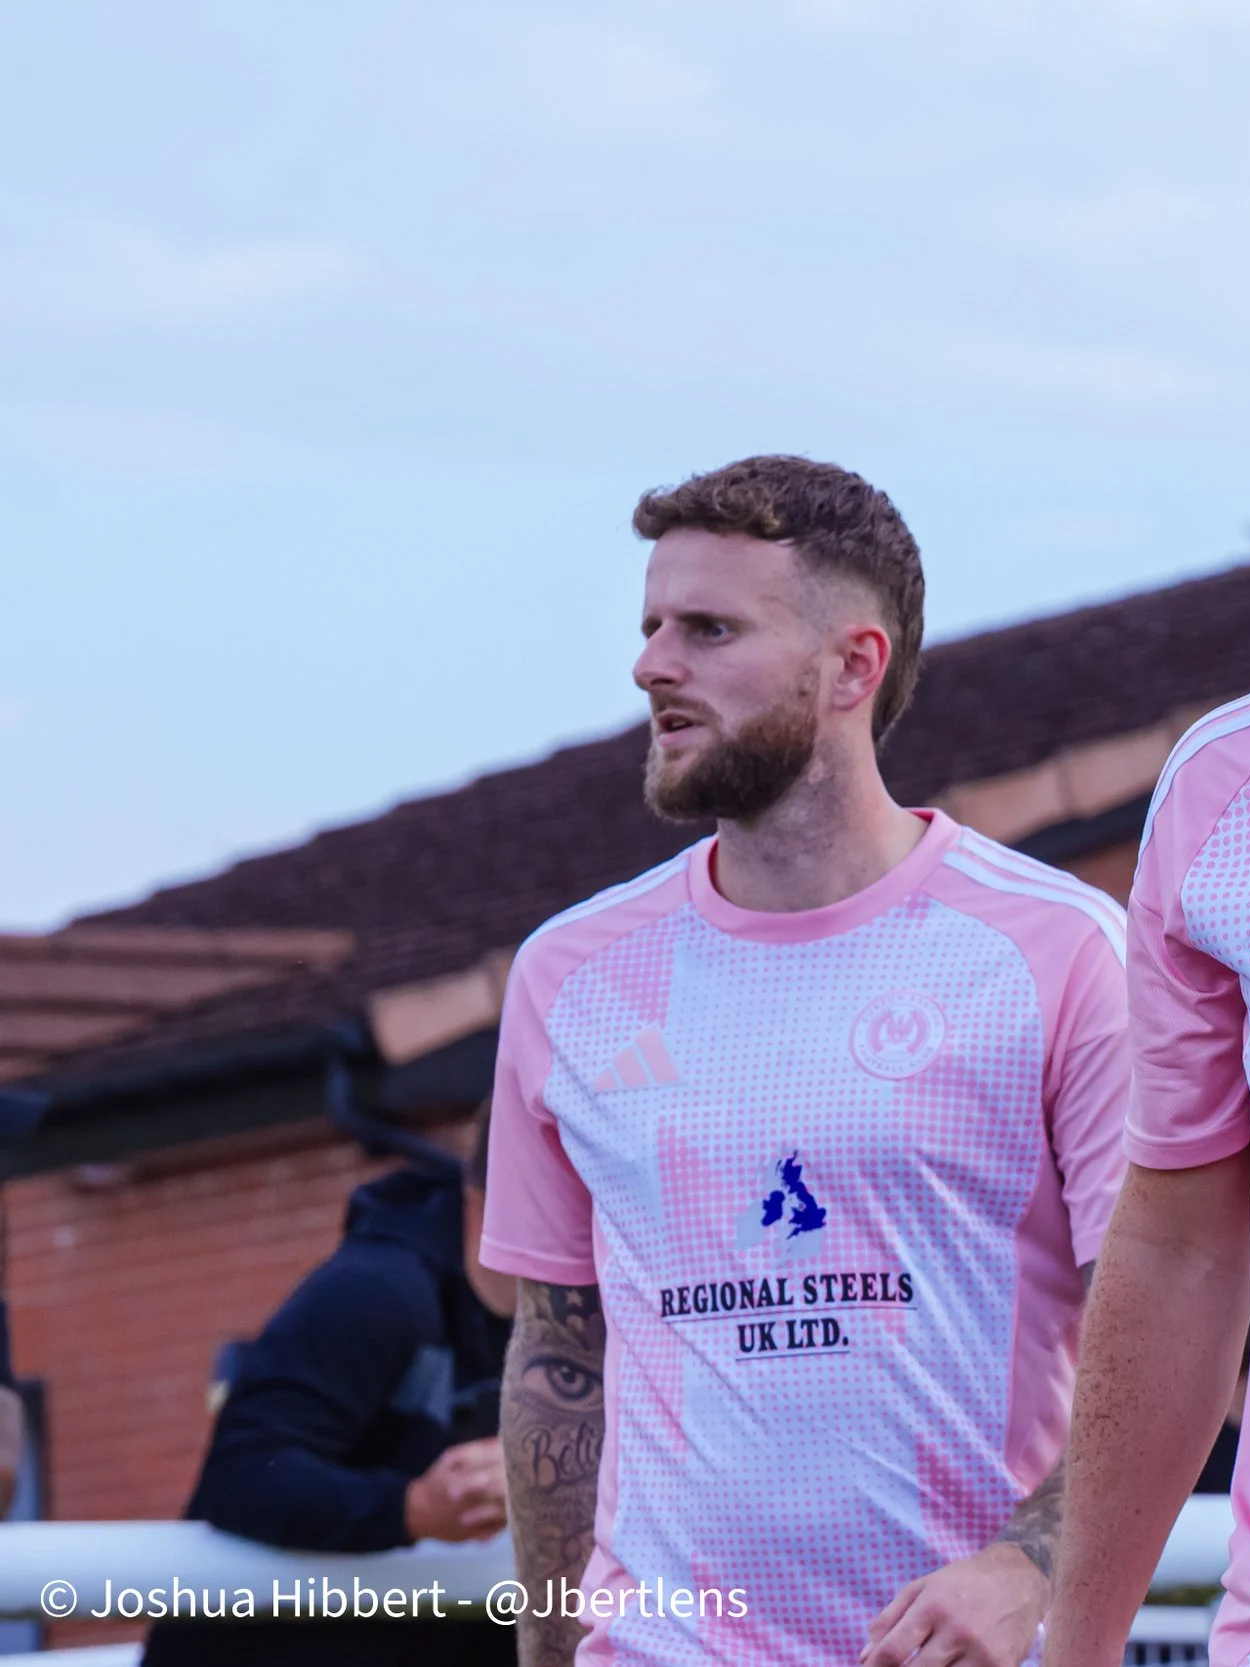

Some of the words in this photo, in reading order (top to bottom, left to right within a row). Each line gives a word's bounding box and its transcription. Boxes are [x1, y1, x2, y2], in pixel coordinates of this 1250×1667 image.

[661, 1278, 794, 1317] REGIONAL
[803, 1273, 914, 1305] STEELS
[738, 1321, 777, 1353] UK
[787, 1317, 849, 1349] LTD.
